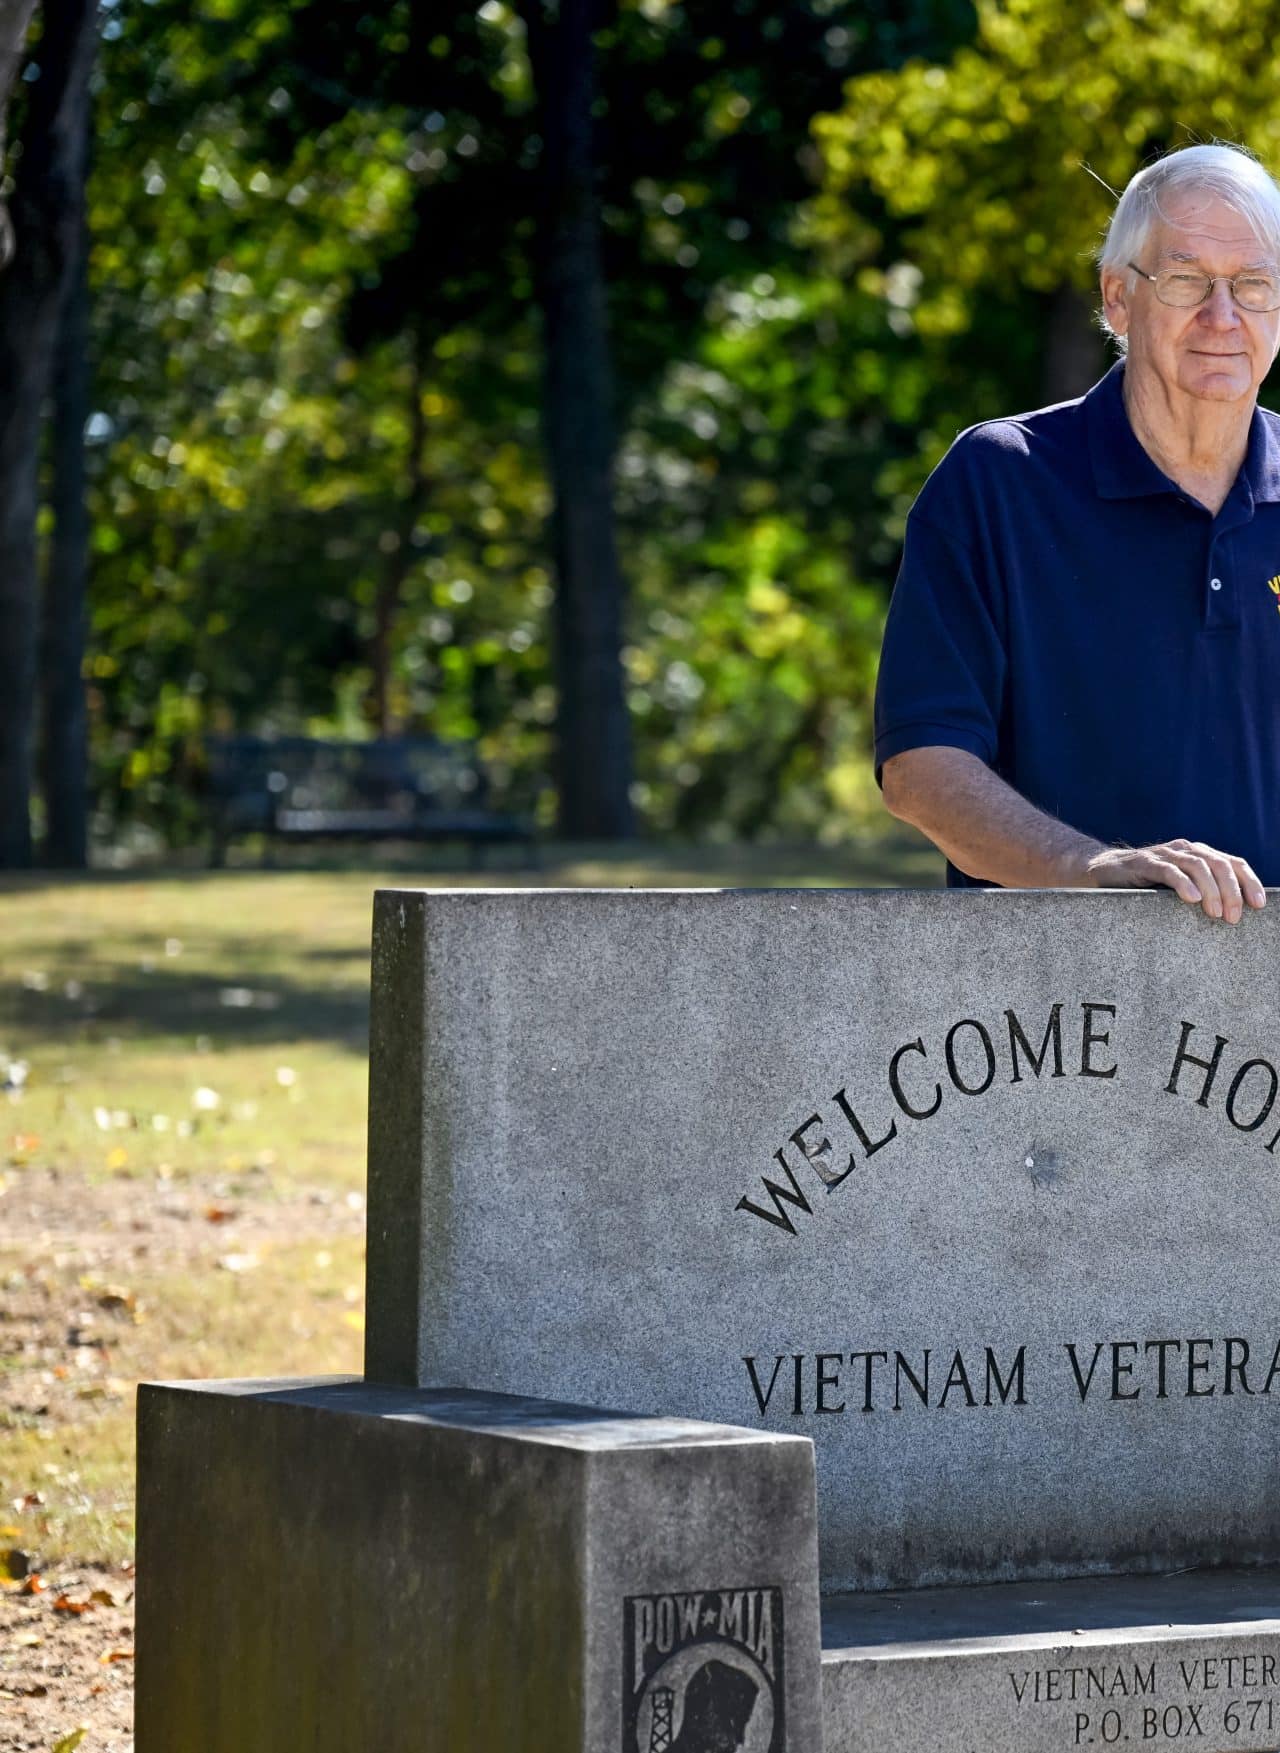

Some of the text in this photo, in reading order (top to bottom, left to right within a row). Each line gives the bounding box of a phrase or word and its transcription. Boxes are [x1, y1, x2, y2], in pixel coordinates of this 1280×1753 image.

[735, 1002, 1118, 1236] WELCOME
[741, 1346, 1028, 1417] VIETNAM
[632, 1590, 776, 1694] POW MIA
[1008, 1662, 1156, 1704] VIETNAM
[1075, 1710, 1129, 1745] P.O.
[1142, 1704, 1206, 1740] BOX
